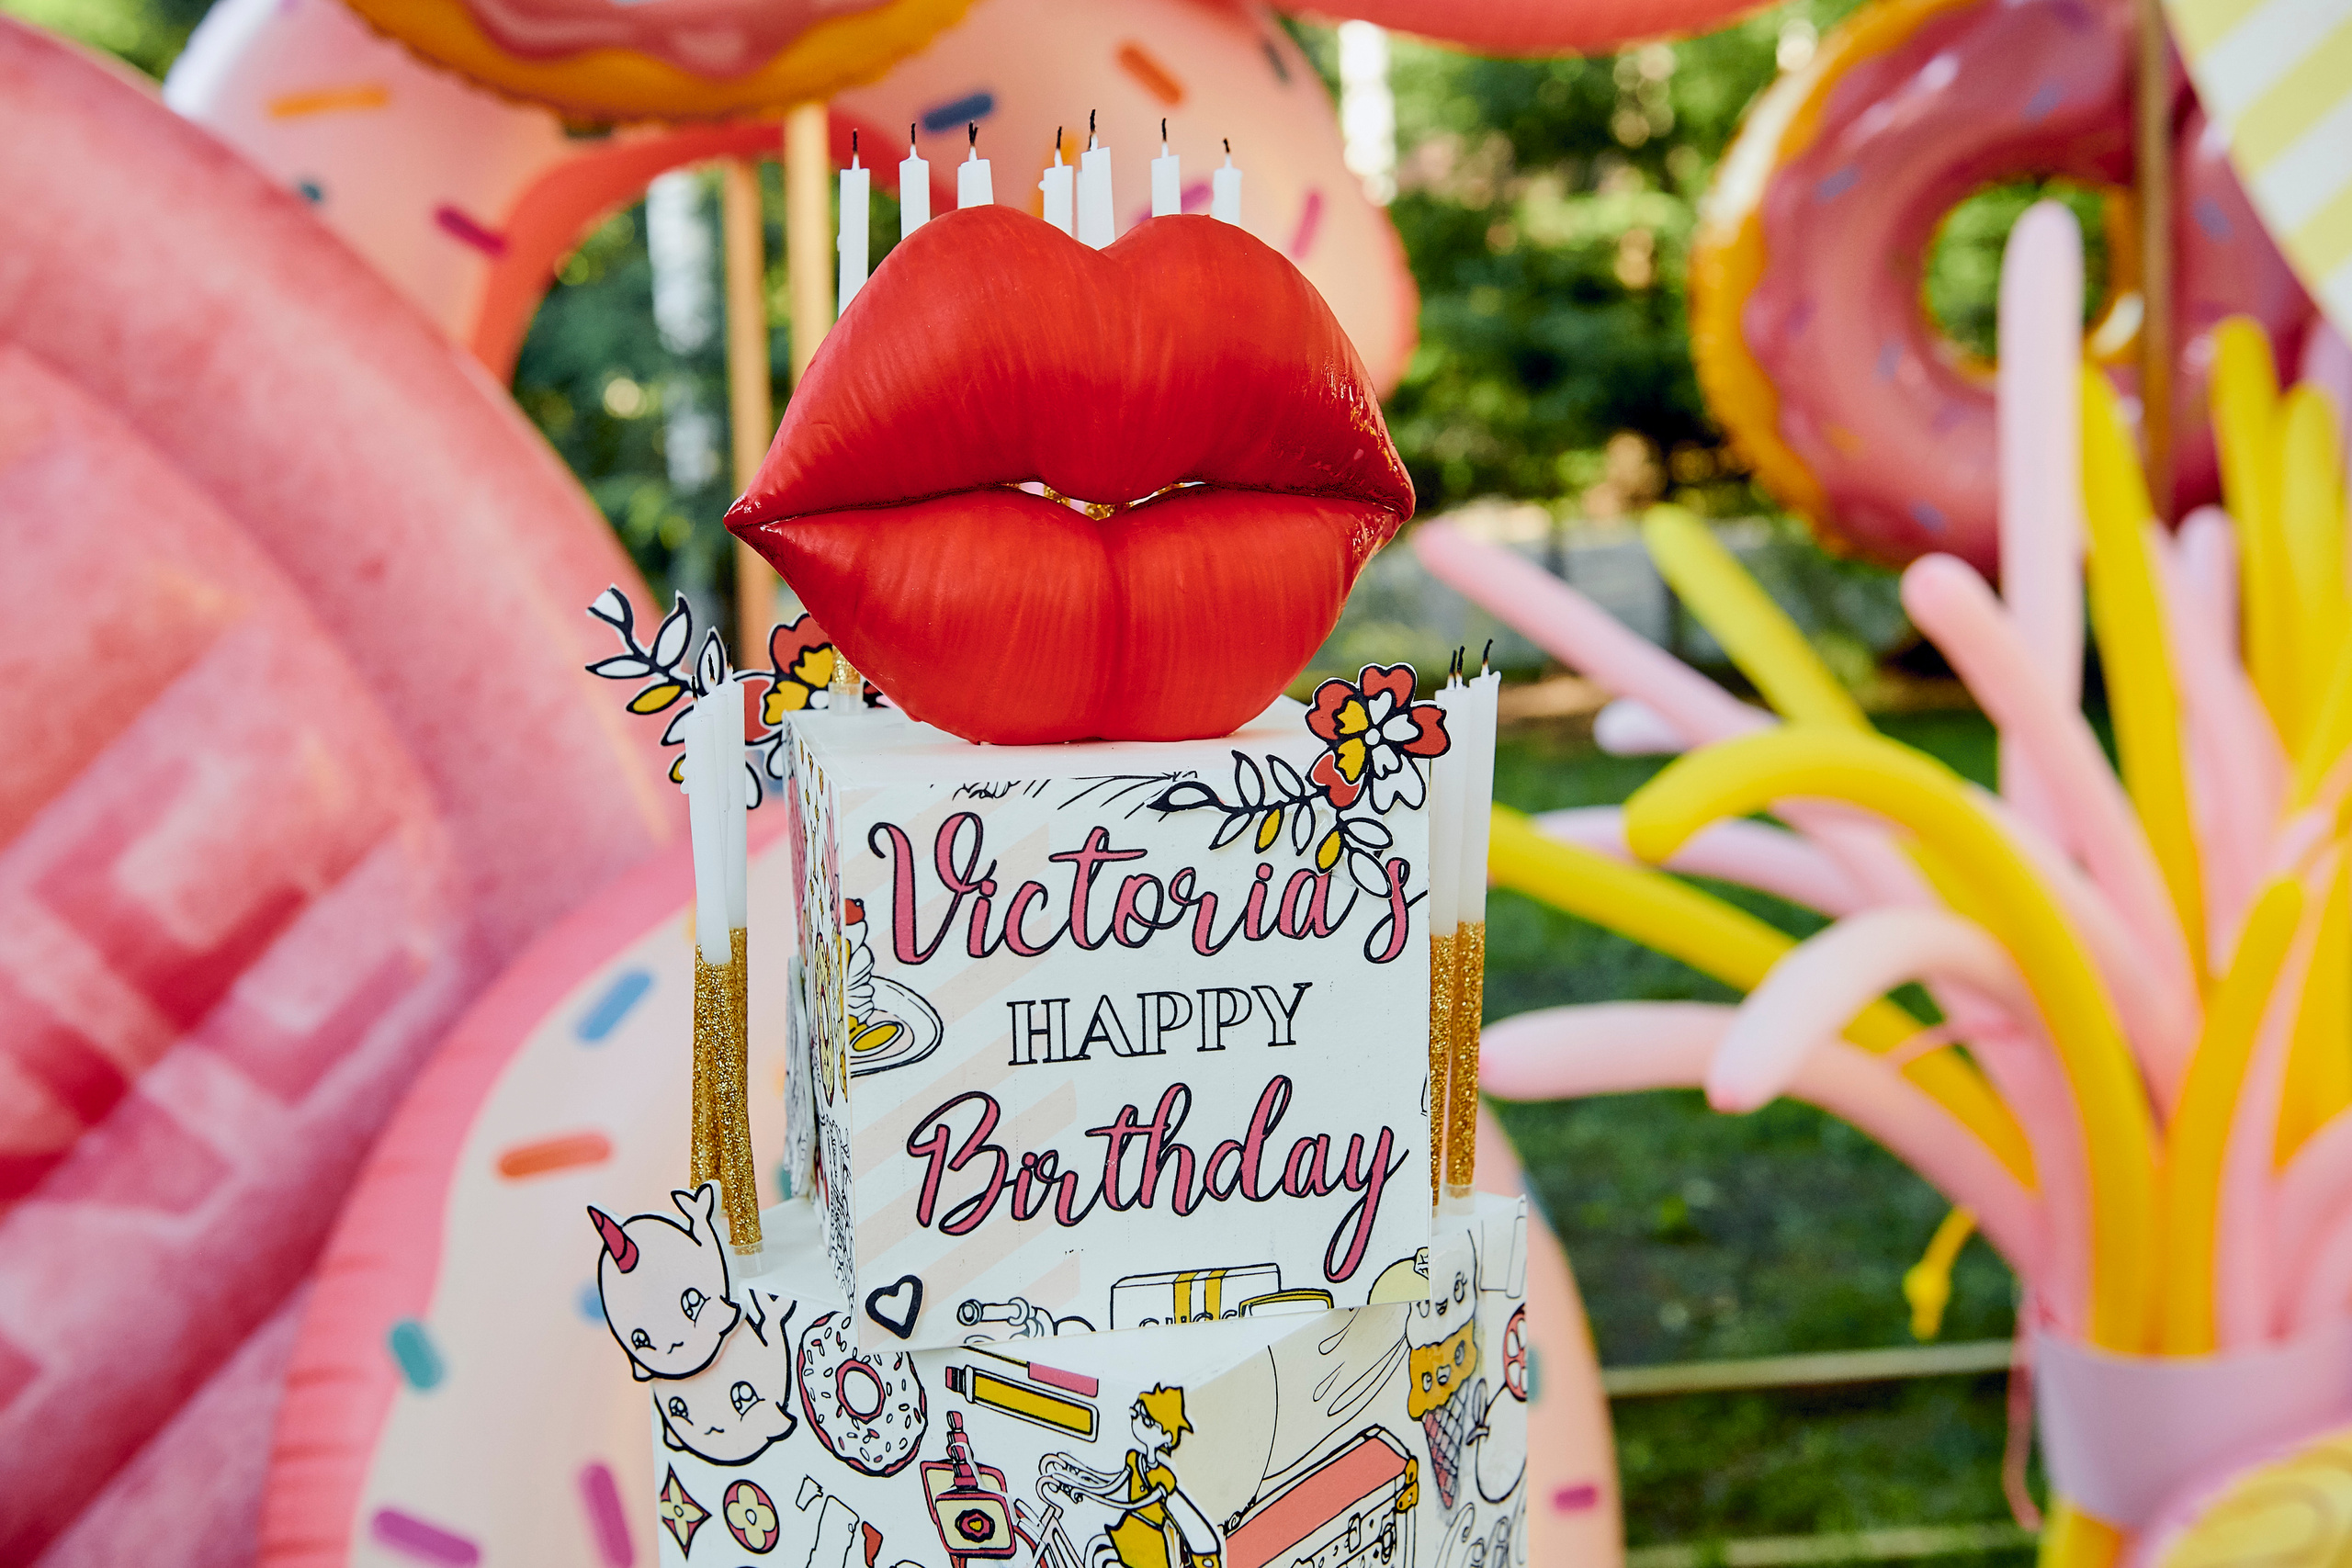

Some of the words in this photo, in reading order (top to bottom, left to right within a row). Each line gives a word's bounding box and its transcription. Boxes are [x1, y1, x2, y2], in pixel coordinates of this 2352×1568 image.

[867, 812, 1428, 965] Victorias
[1007, 981, 1313, 1066] HAPPY
[906, 1074, 1410, 1282] Birthday
